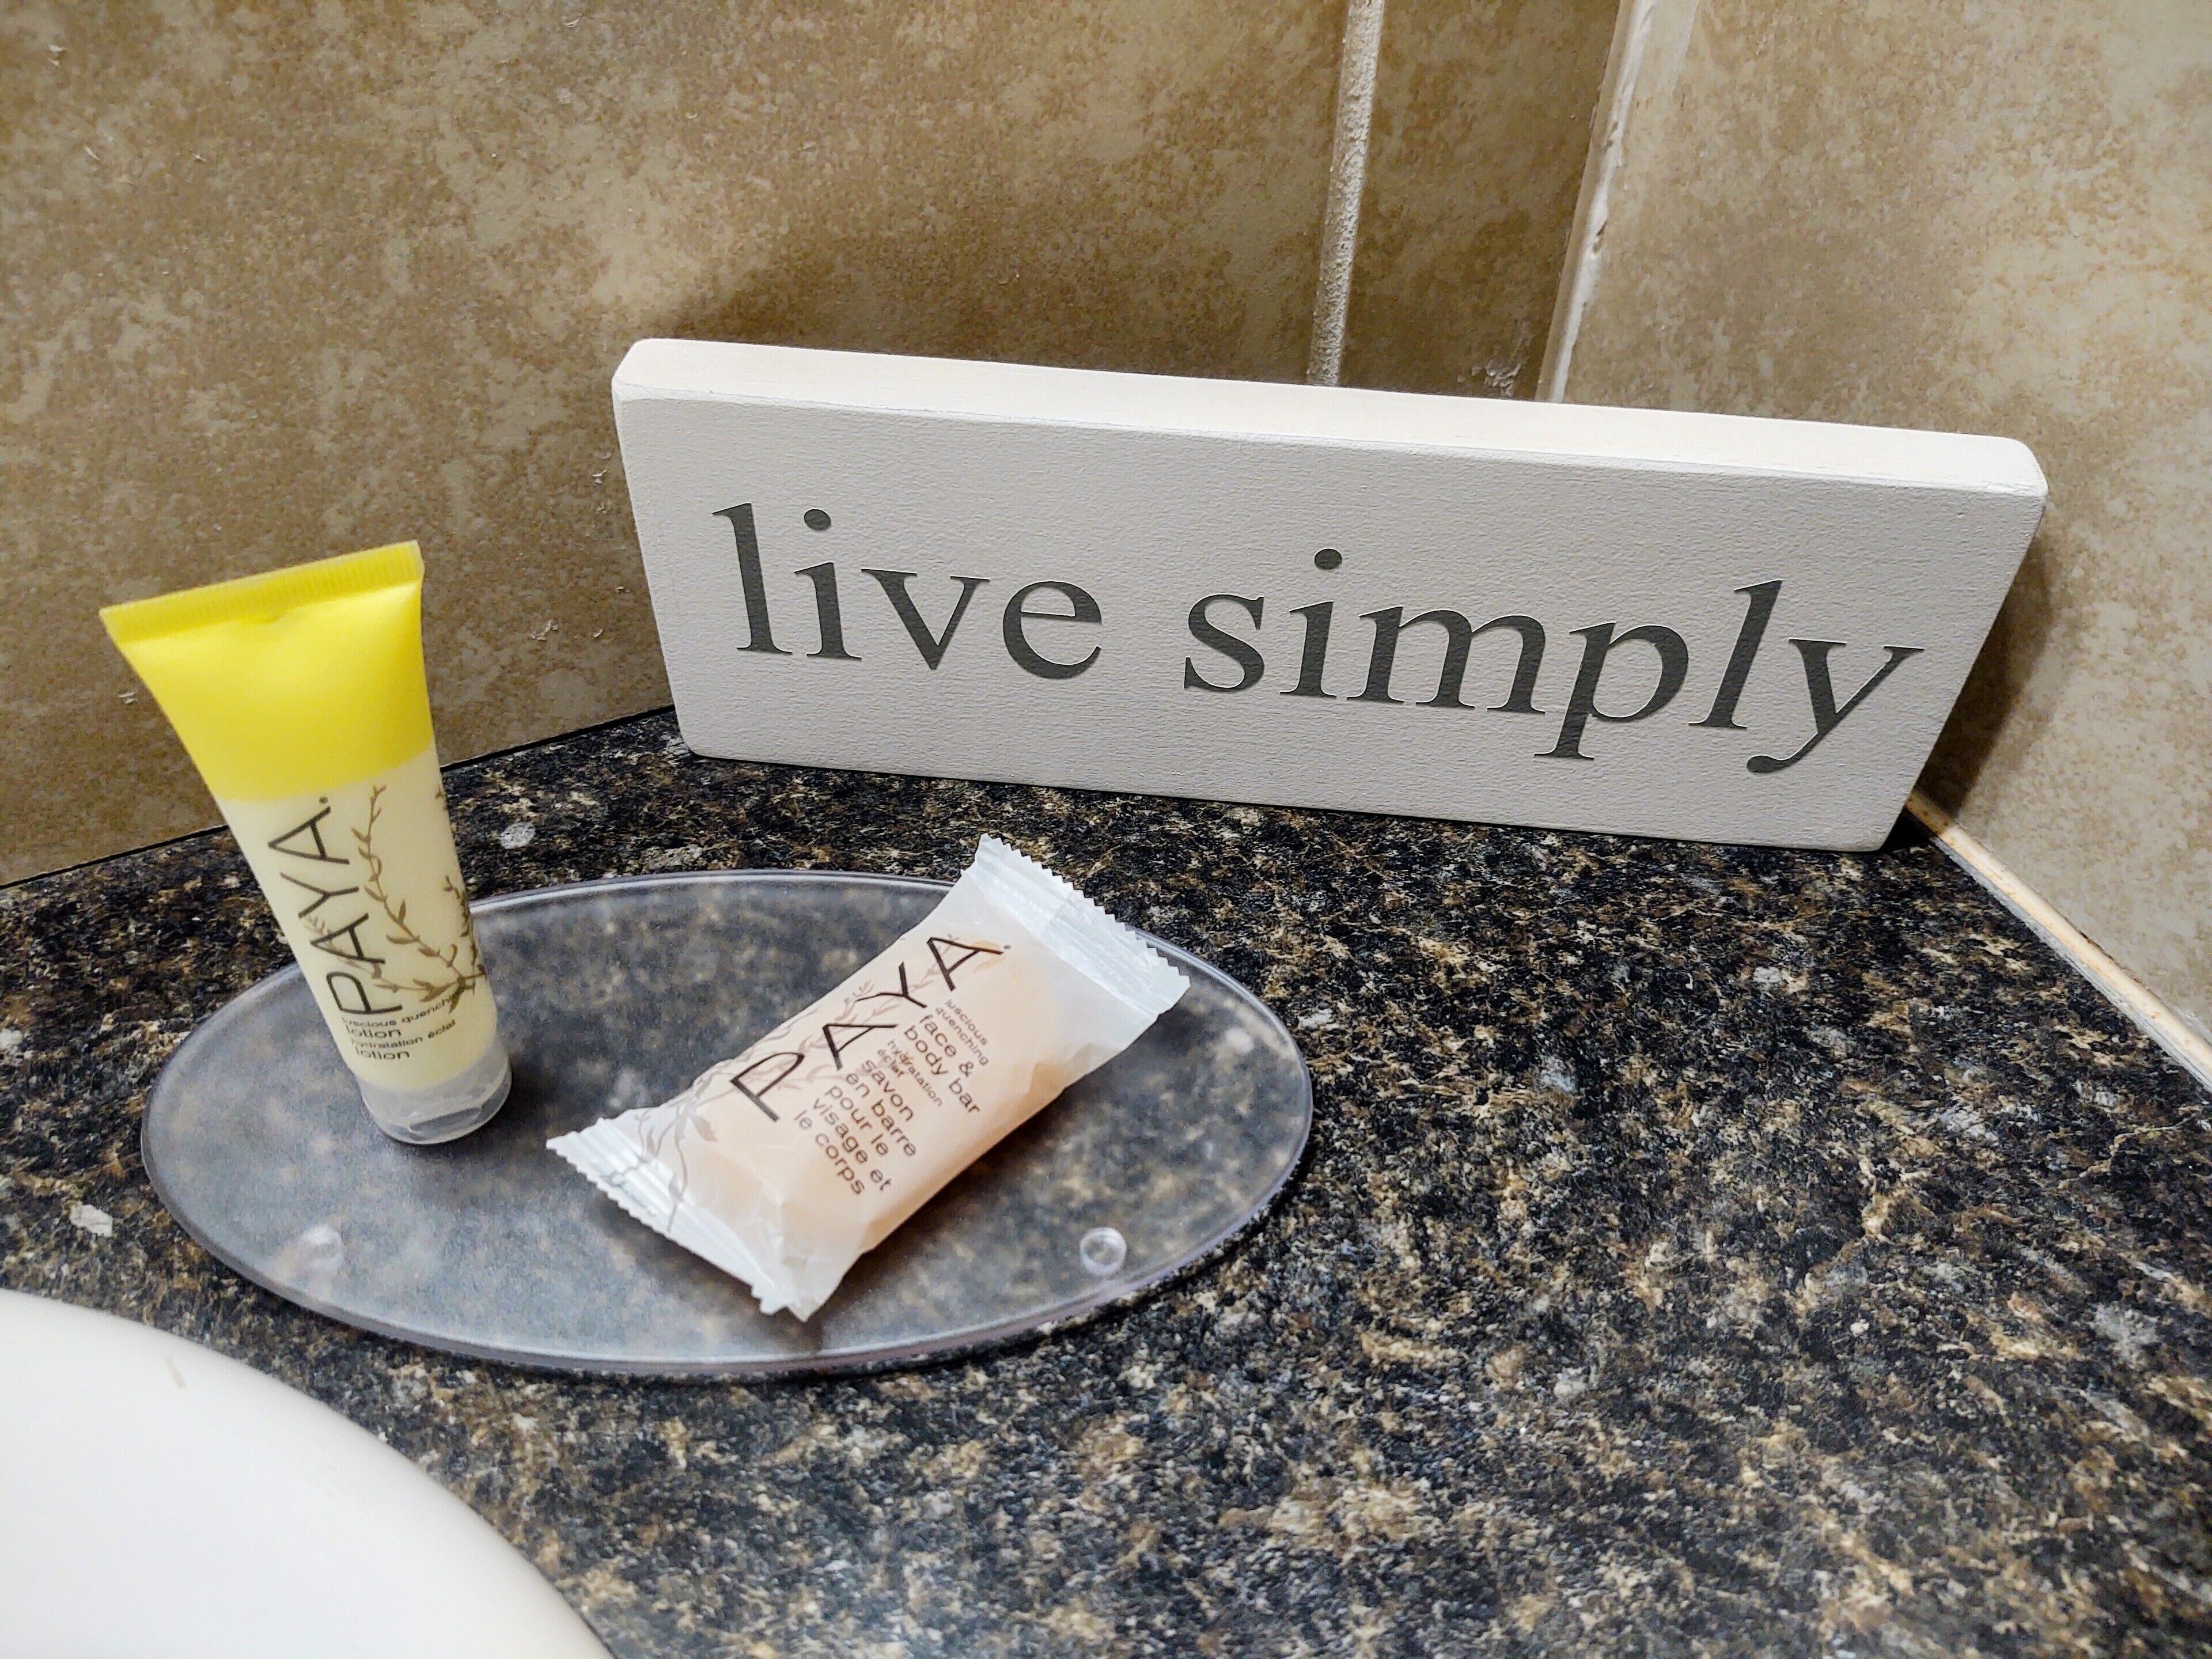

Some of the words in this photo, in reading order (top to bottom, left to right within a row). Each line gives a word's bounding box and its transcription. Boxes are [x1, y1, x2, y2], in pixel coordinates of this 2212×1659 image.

[712, 503, 1103, 680] live
[1183, 548, 1925, 774] simply
[346, 1024, 402, 1039] lotion
[354, 1046, 411, 1060] lotion
[919, 1014, 957, 1058] face
[959, 1060, 975, 1078] &
[935, 1006, 990, 1066] quenching
[945, 999, 989, 1046] luscious
[862, 1059, 914, 1122] savon
[888, 1039, 944, 1108] hydratation
[904, 1025, 949, 1076] body
[949, 1077, 981, 1115] bar
[812, 1097, 869, 1164] visage
[870, 1168, 892, 1192] et
[824, 1085, 873, 1130] pour
[870, 1132, 889, 1156] le
[846, 1073, 871, 1099] en
[871, 1099, 917, 1157] barre
[794, 1109, 813, 1130] le
[815, 1132, 866, 1195] corps
